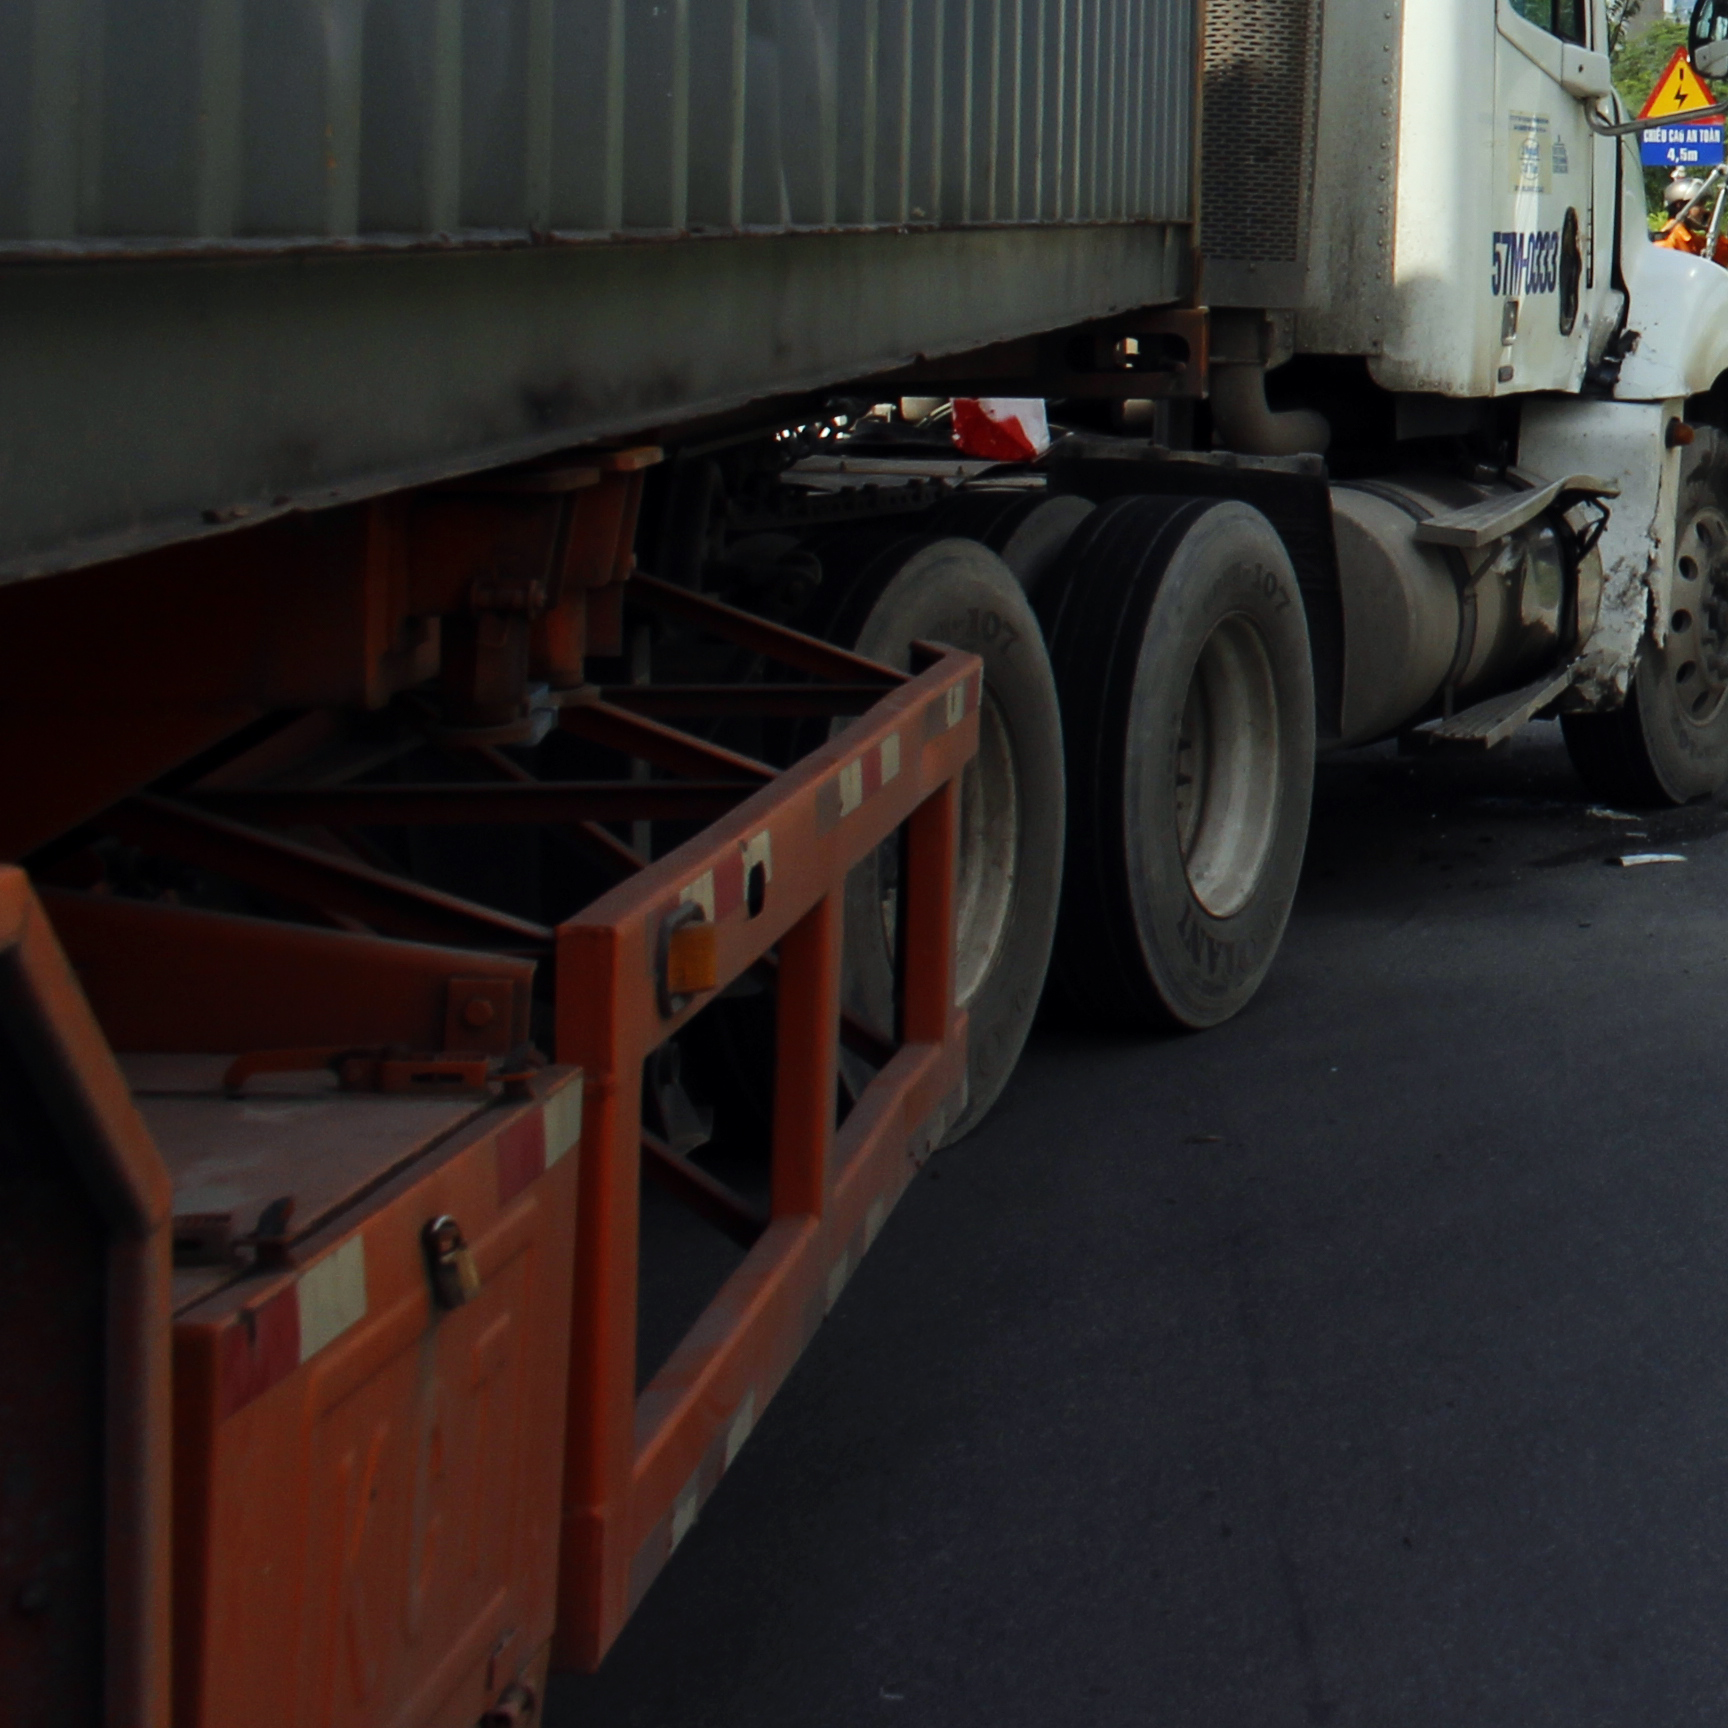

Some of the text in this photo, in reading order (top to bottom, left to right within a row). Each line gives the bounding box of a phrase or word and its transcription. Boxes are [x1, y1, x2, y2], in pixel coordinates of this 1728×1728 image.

[1686, 129, 1698, 143] AN
[1699, 127, 1721, 143] TOÀN
[1667, 148, 1698, 163] 4,5m
[1492, 231, 1560, 297] 57M-0333
